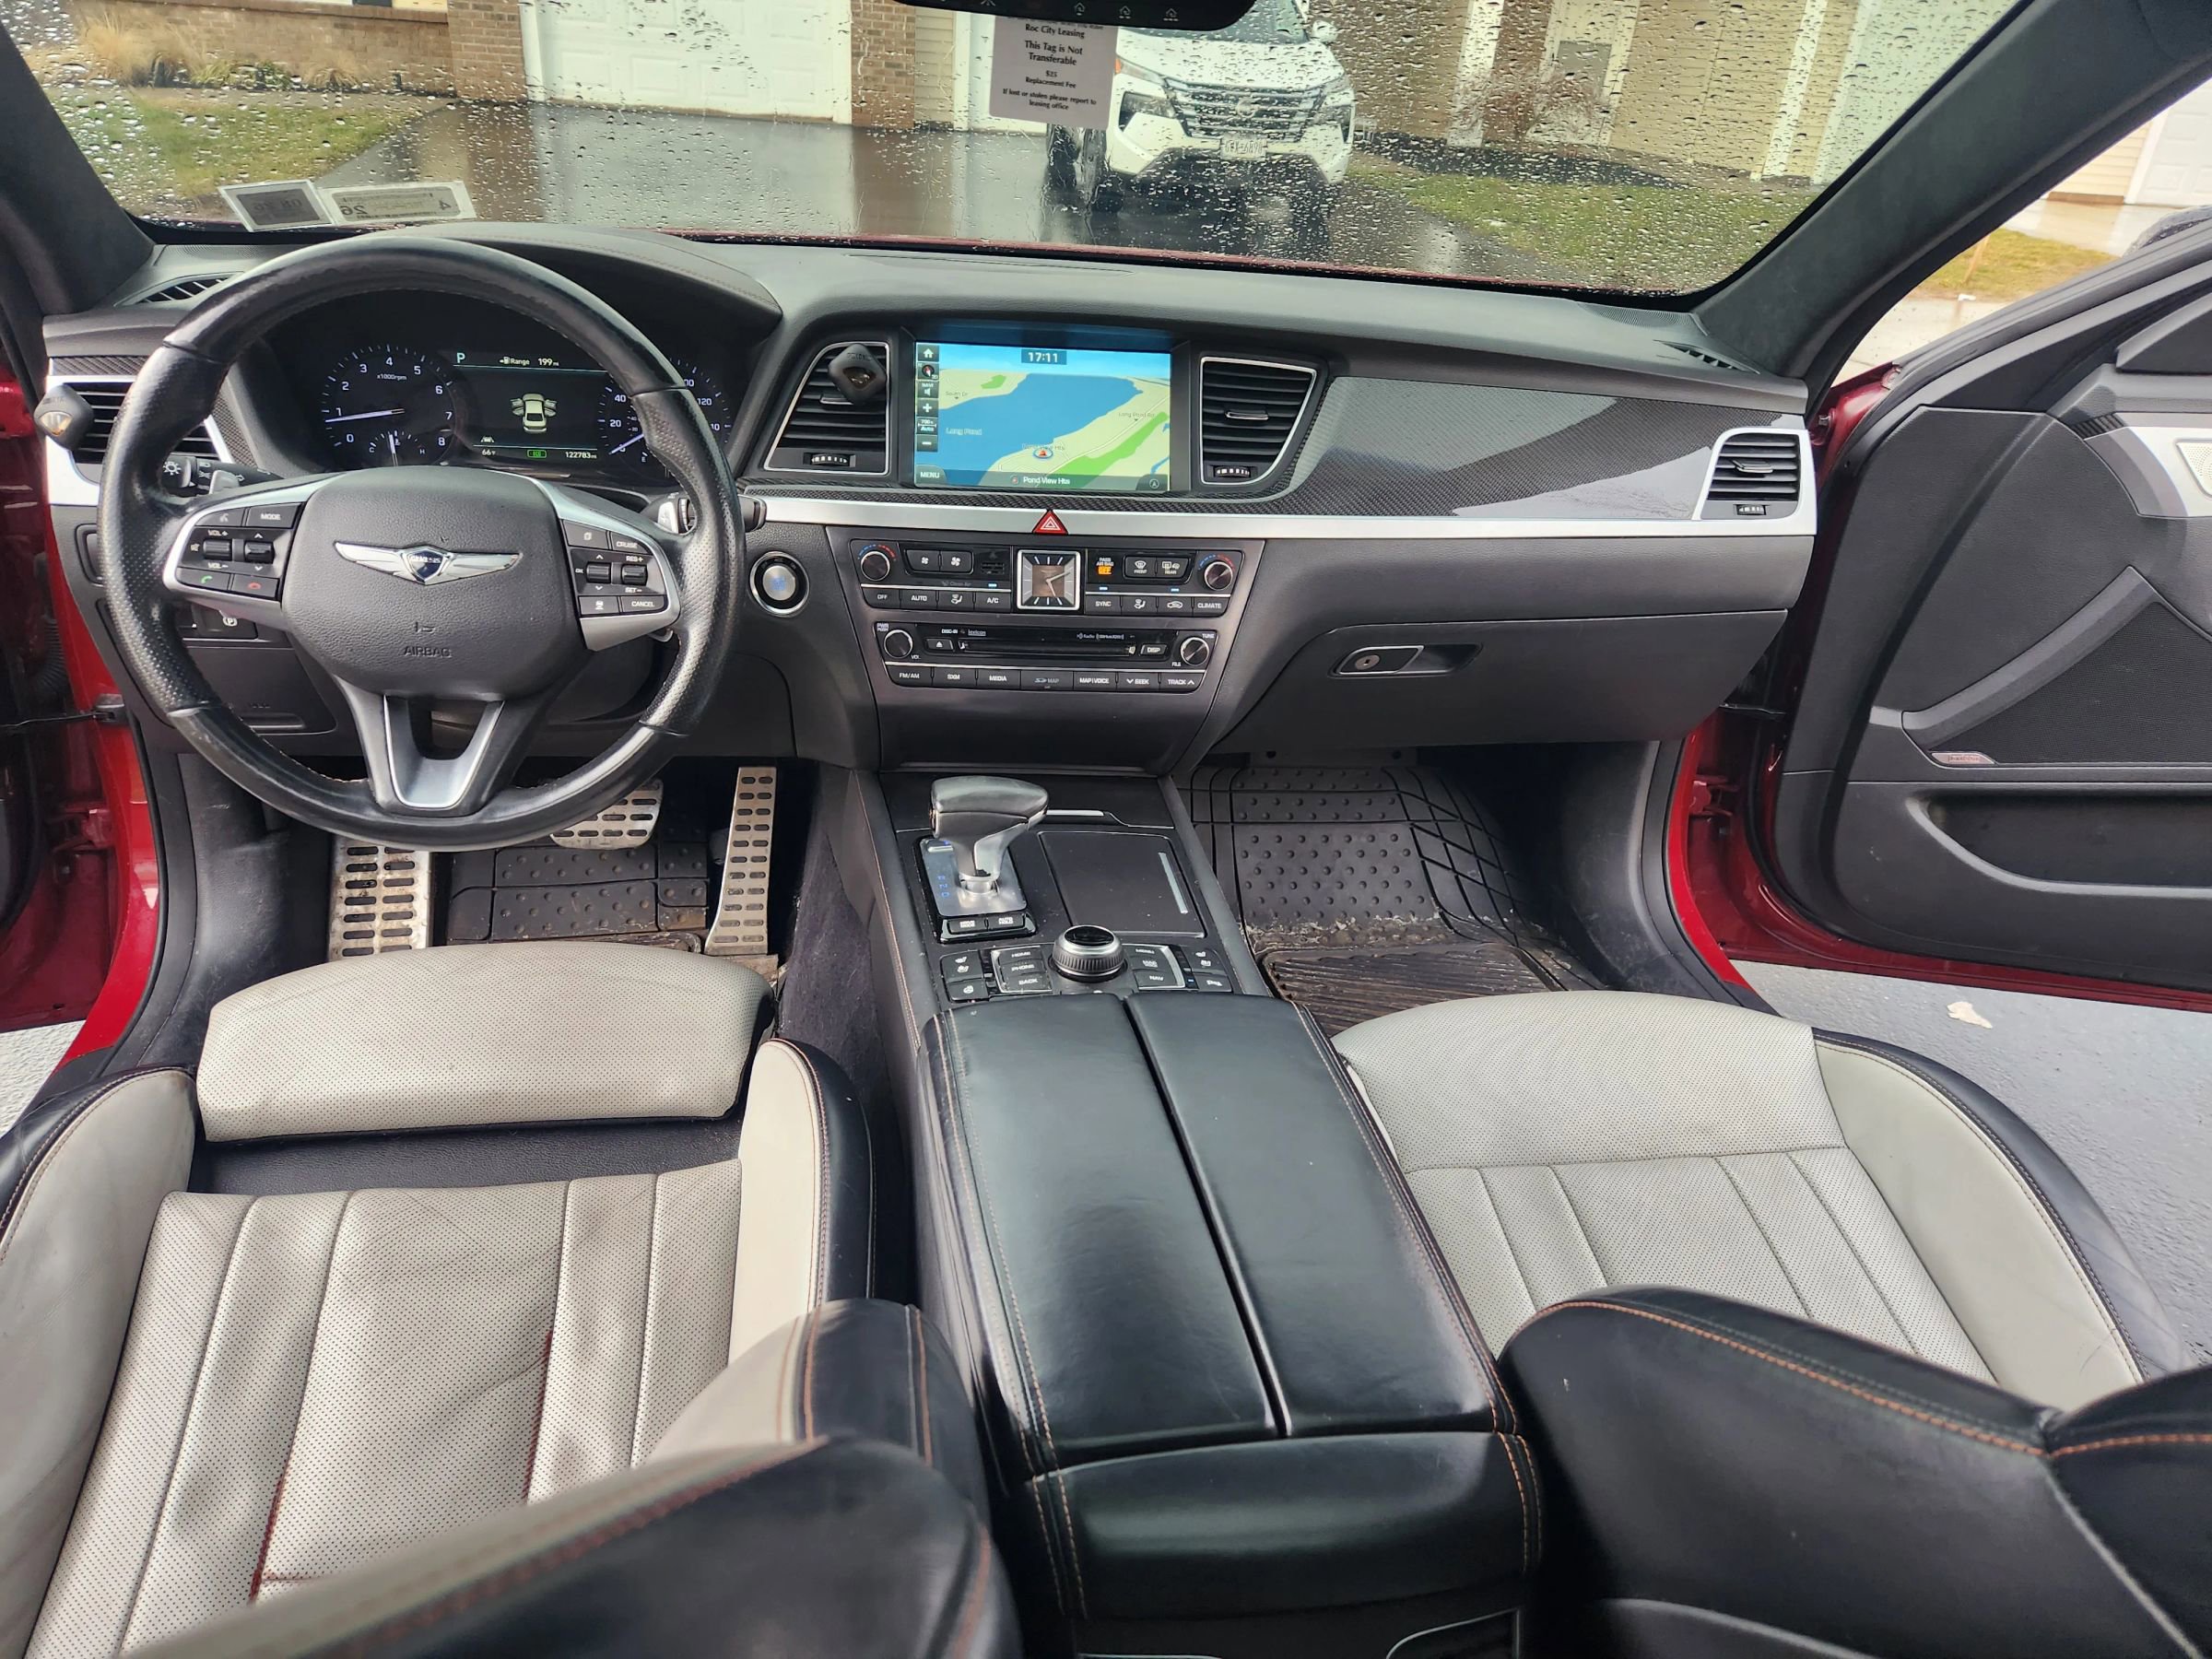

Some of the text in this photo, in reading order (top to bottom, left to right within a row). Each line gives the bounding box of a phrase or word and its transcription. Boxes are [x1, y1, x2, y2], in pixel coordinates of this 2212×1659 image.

[1025, 24, 1085, 39] Roc City Leasing
[1025, 40, 1083, 55] This Tag is Not
[1029, 53, 1077, 65] Transferable
[1025, 76, 1065, 88] Replacement
[1049, 93, 1068, 101] please
[1069, 96, 1088, 104] report
[1029, 100, 1051, 109] leasing
[386, 357, 393, 366] 4
[456, 353, 465, 363] P
[1028, 351, 1058, 363] 17:11
[511, 358, 530, 366] Range
[359, 363, 368, 373] 3
[414, 366, 421, 375] 5
[342, 381, 349, 391] 2
[684, 379, 695, 387] 00
[435, 385, 442, 394] 6
[615, 394, 627, 403] 40
[446, 411, 453, 420] 7
[609, 419, 622, 428] 20
[945, 427, 982, 436] Long Pond
[346, 433, 354, 443] 0
[438, 437, 445, 446] 8
[1023, 476, 1041, 485] Pond
[404, 646, 452, 657] AIRBAG
